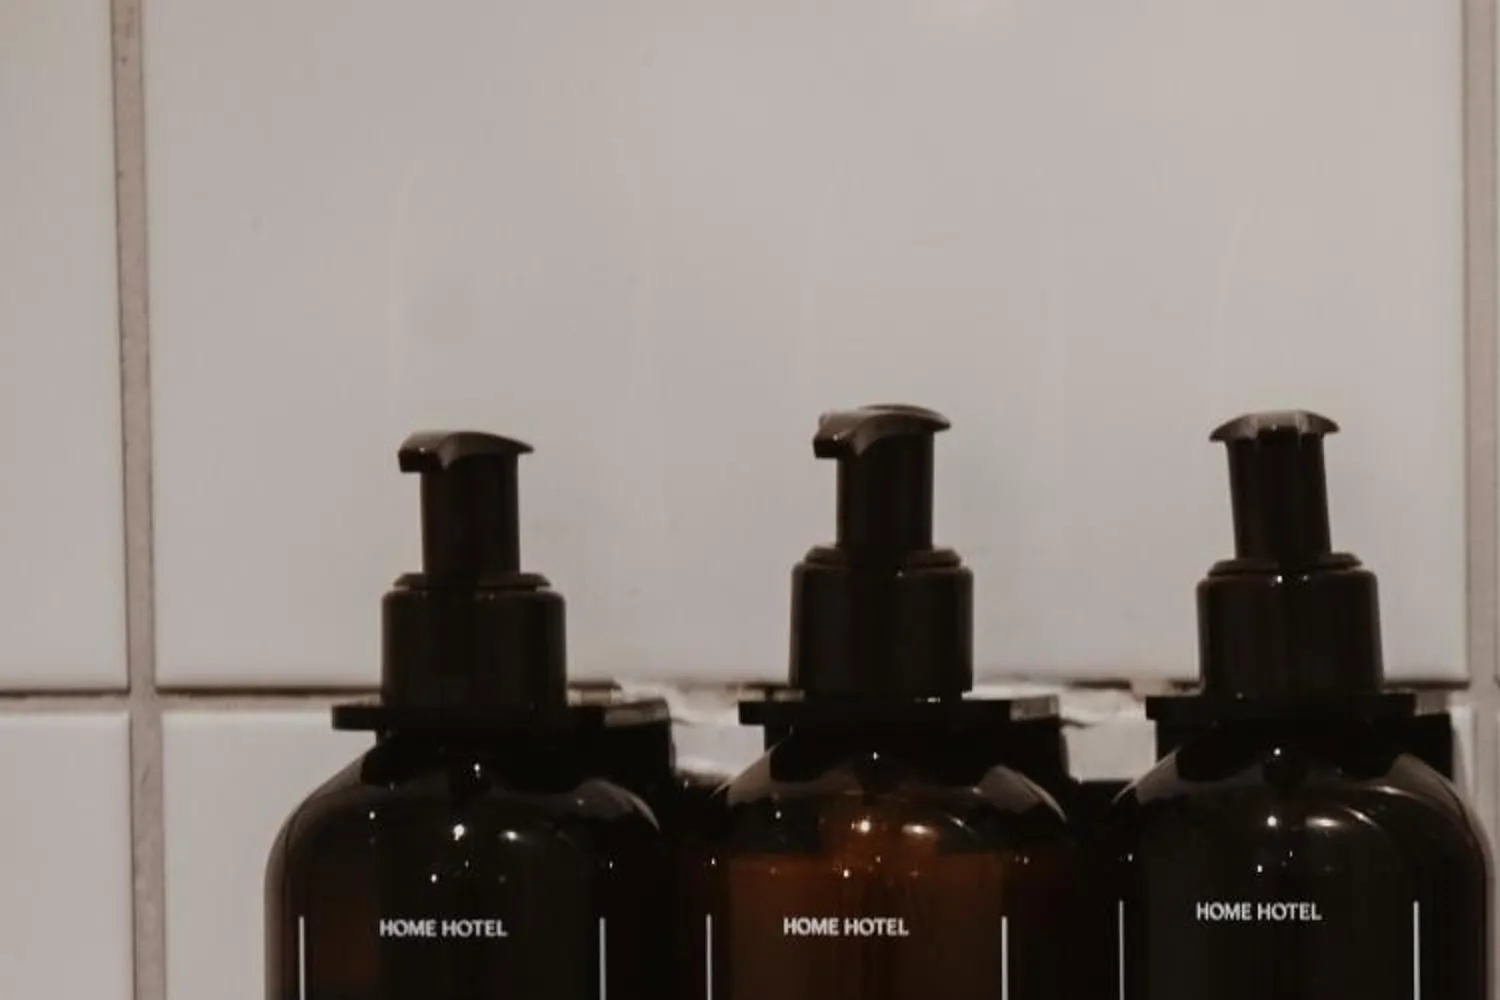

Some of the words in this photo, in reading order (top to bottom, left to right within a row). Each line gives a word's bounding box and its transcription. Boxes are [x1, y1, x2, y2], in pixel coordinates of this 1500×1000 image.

[1195, 901, 1253, 921] HOME
[1256, 901, 1323, 921] HOTEL
[379, 918, 437, 938] HOME
[441, 919, 509, 938] HOTEL
[782, 916, 840, 937] HOME
[843, 917, 910, 937] HOTEL
